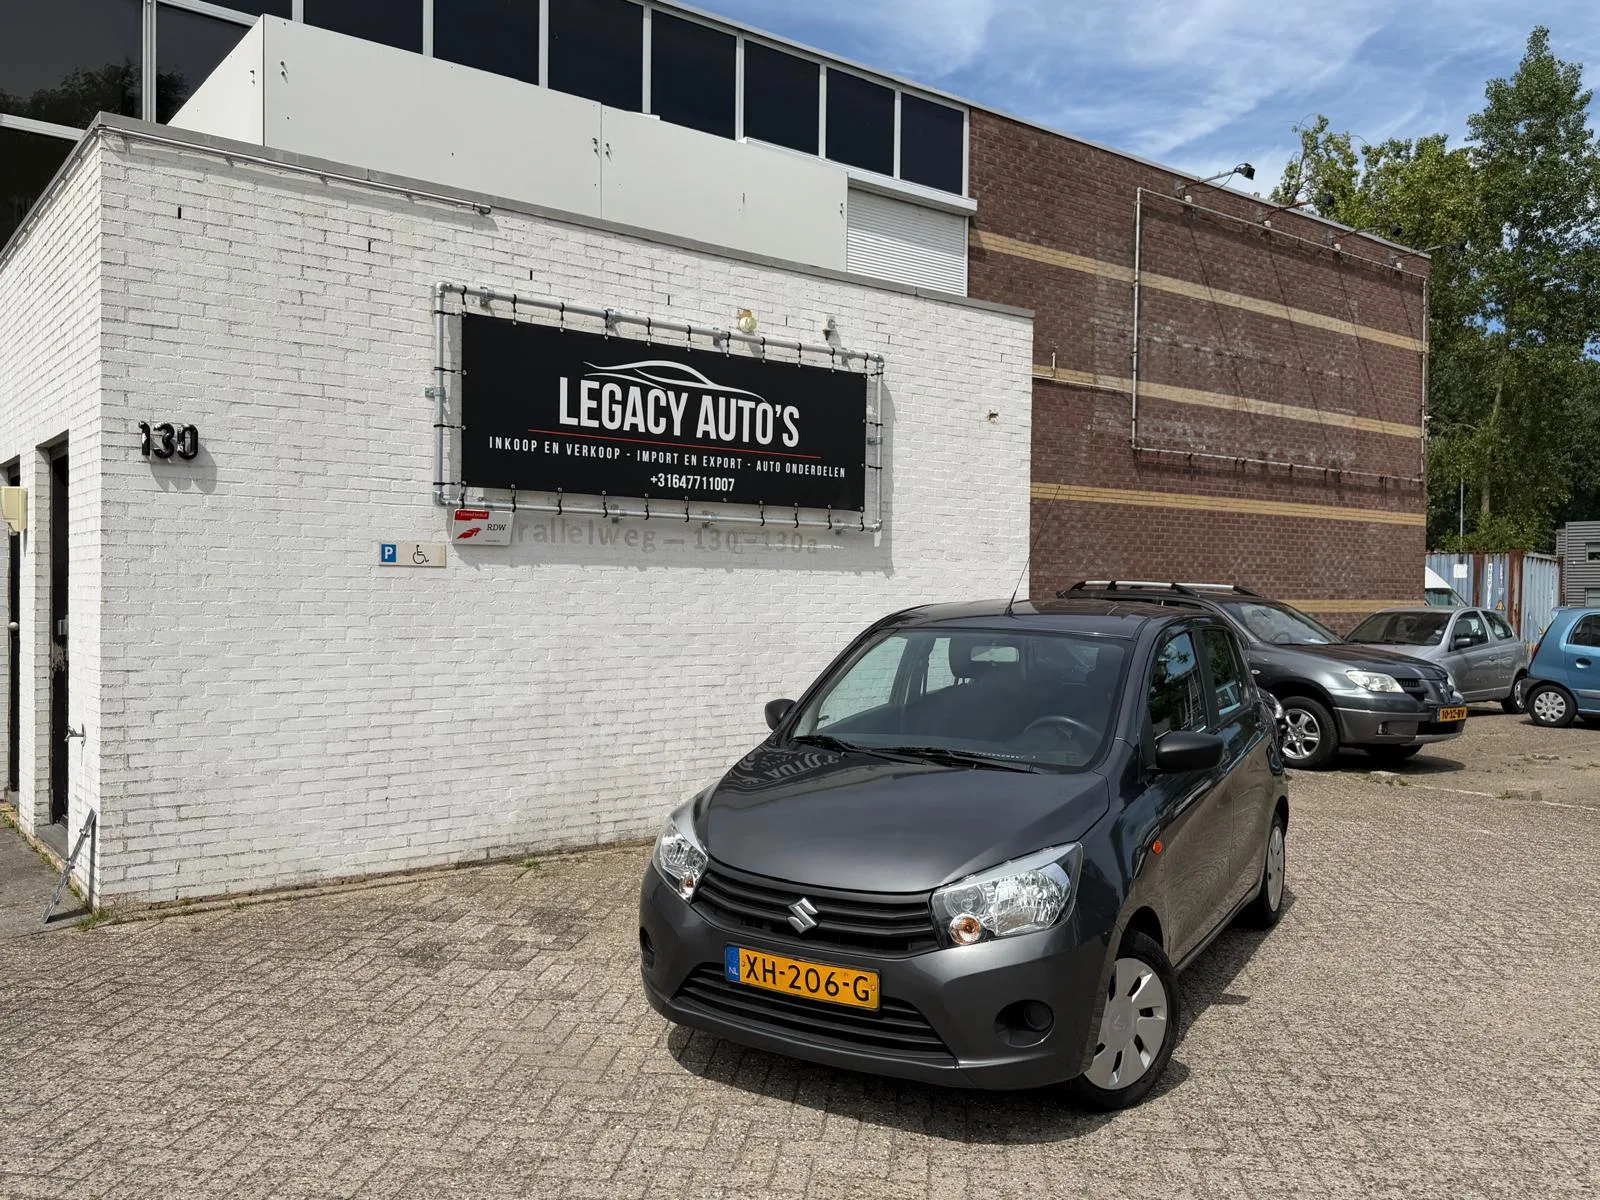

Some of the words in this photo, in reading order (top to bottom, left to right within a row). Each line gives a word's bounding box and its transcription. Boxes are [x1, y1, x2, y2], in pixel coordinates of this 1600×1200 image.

[559, 376, 689, 437] LEGACY
[695, 394, 801, 448] AUTO'S
[138, 420, 199, 460] 130
[489, 435, 538, 452] INKOOP
[544, 441, 559, 455] EN
[566, 443, 621, 460] VERKOOP
[636, 449, 680, 466] IMPORT
[684, 454, 698, 466] EN
[702, 455, 743, 471] EXPORT
[755, 460, 782, 474] AUTO
[785, 462, 847, 479] ONDERDELEN
[650, 472, 736, 492] +31647711007
[486, 523, 507, 532] RDW
[517, 516, 657, 553] rallelweg
[384, 546, 394, 560] P
[728, 966, 739, 976] NL
[745, 953, 871, 1002] XH-206-G
